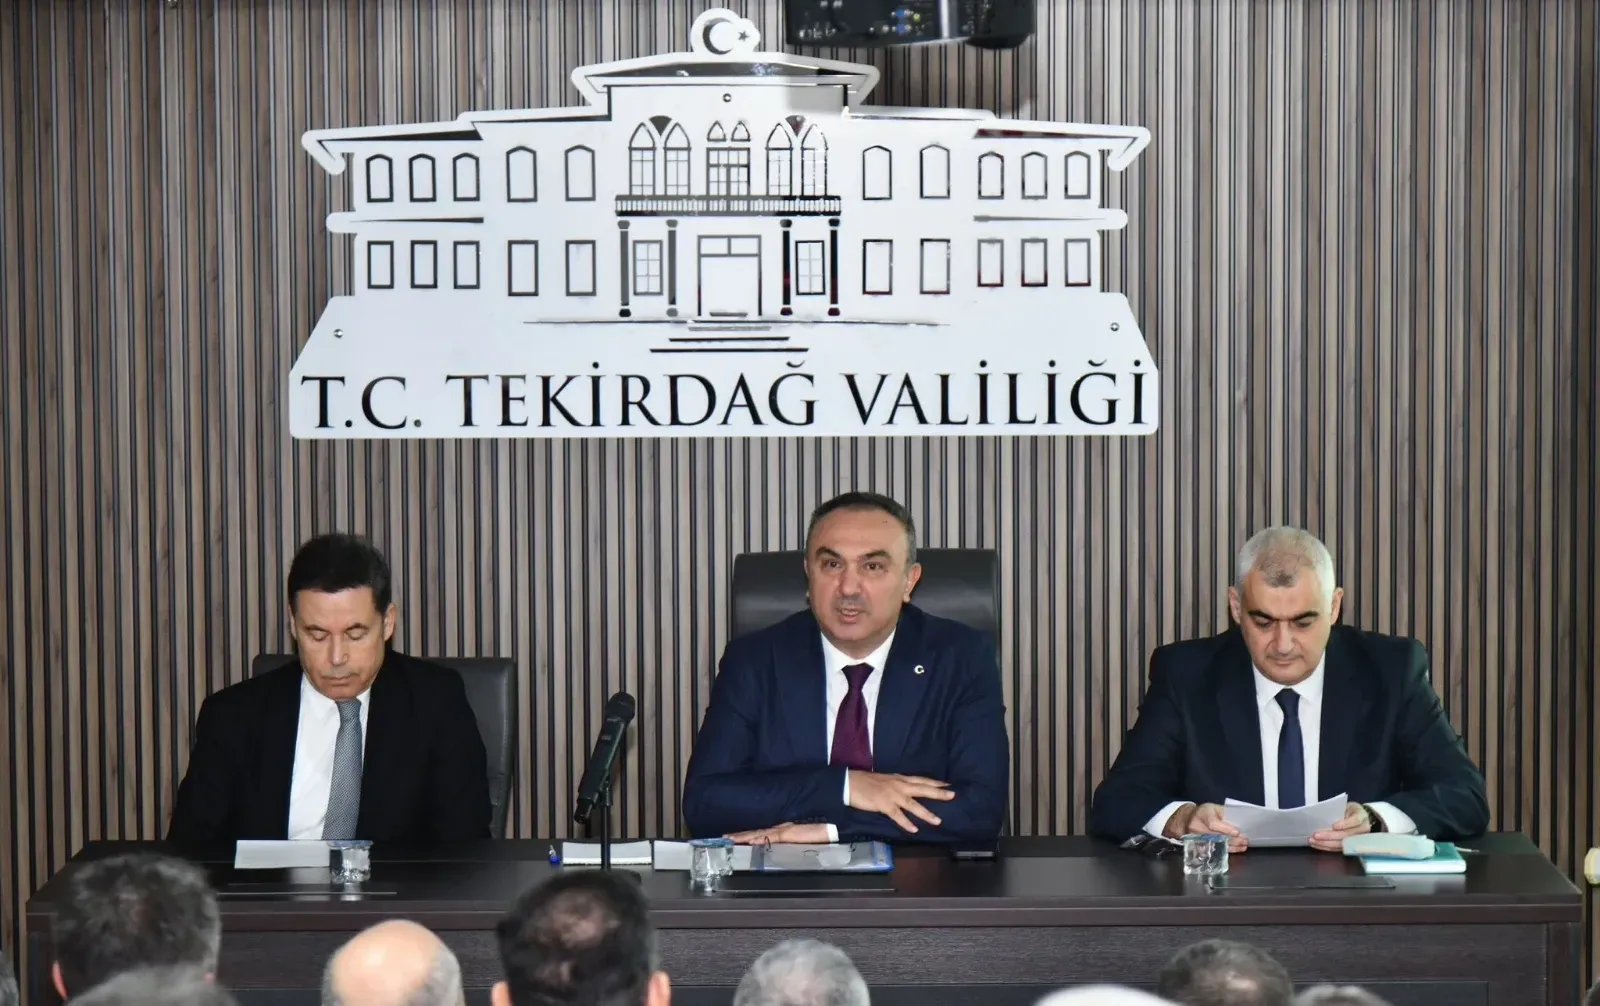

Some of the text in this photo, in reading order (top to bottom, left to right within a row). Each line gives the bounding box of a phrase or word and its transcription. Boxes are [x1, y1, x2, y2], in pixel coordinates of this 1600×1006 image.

[301, 359, 1144, 429] T.C. TEKİRDAĞ VALİLİĞİ
